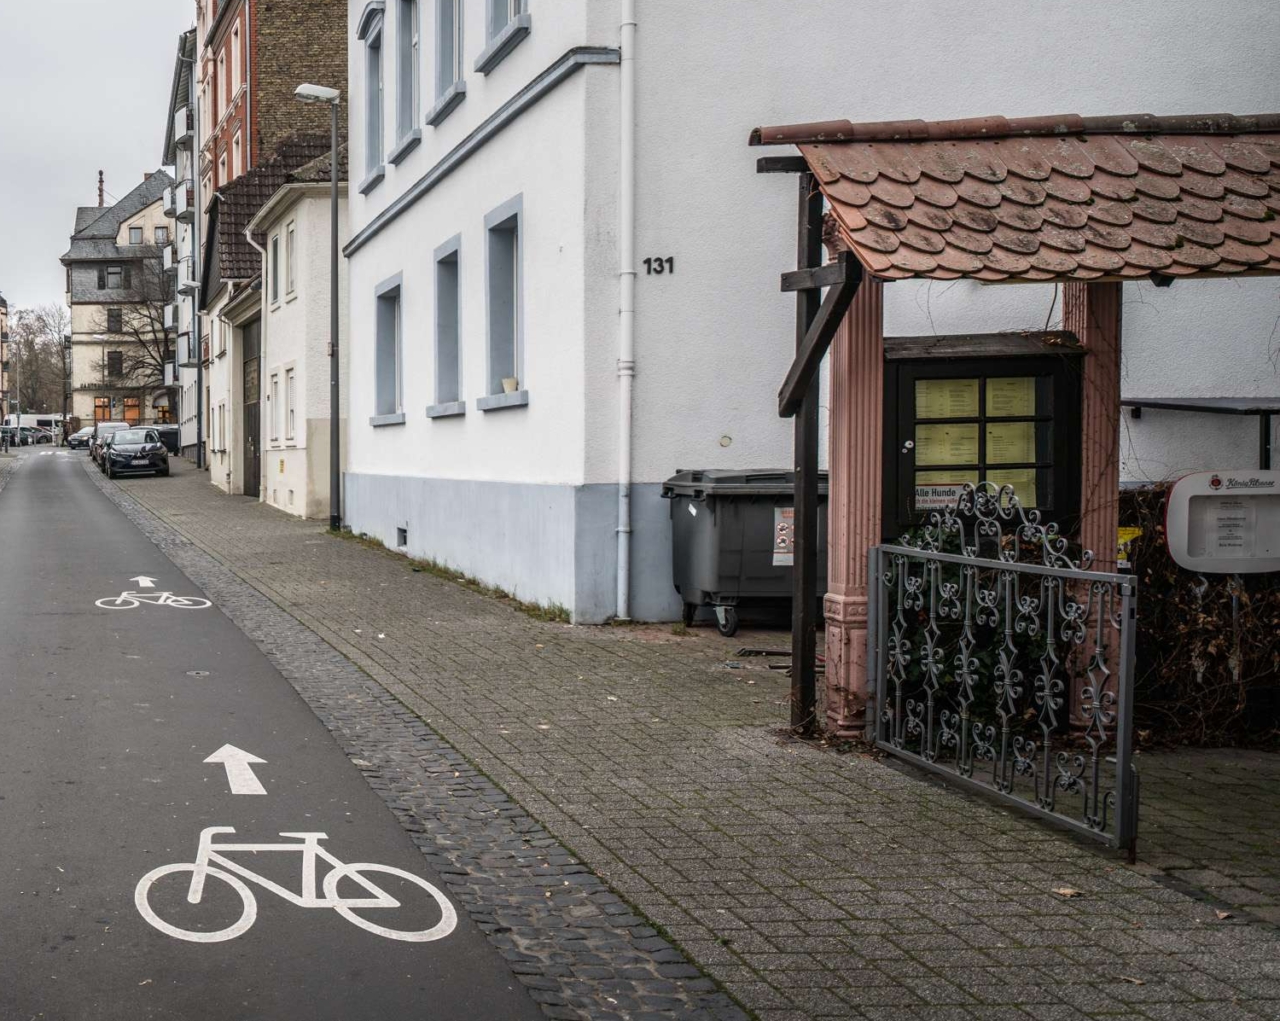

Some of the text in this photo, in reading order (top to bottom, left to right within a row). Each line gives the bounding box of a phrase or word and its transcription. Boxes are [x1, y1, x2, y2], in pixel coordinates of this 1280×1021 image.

[643, 256, 674, 275] 131
[1225, 478, 1249, 488] König
[916, 487, 956, 497] Alle Hunde
